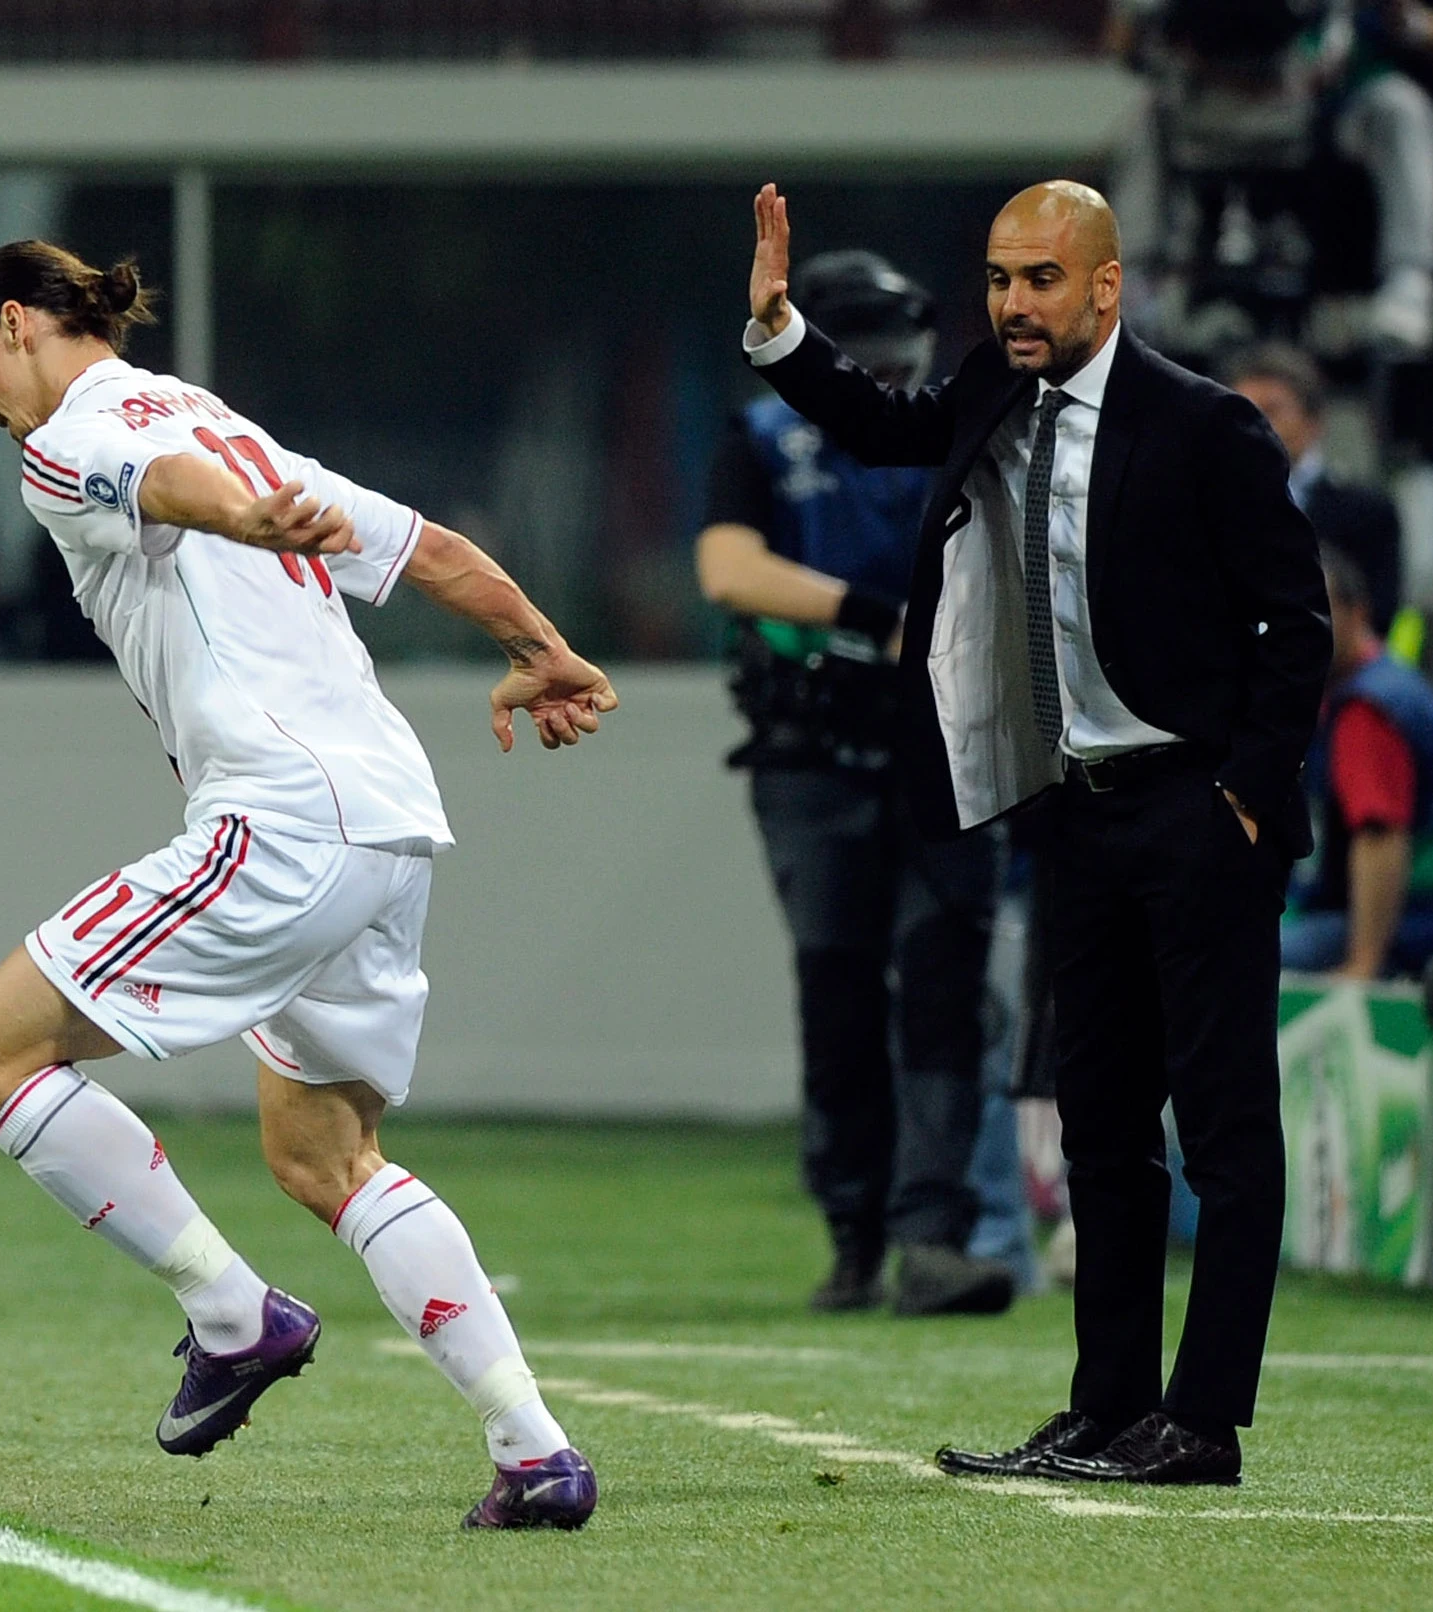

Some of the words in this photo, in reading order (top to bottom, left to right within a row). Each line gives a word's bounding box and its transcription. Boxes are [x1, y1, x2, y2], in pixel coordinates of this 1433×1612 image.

[62, 869, 134, 941] 11
[123, 983, 161, 1015] adidas
[419, 1303, 468, 1339] adidas
